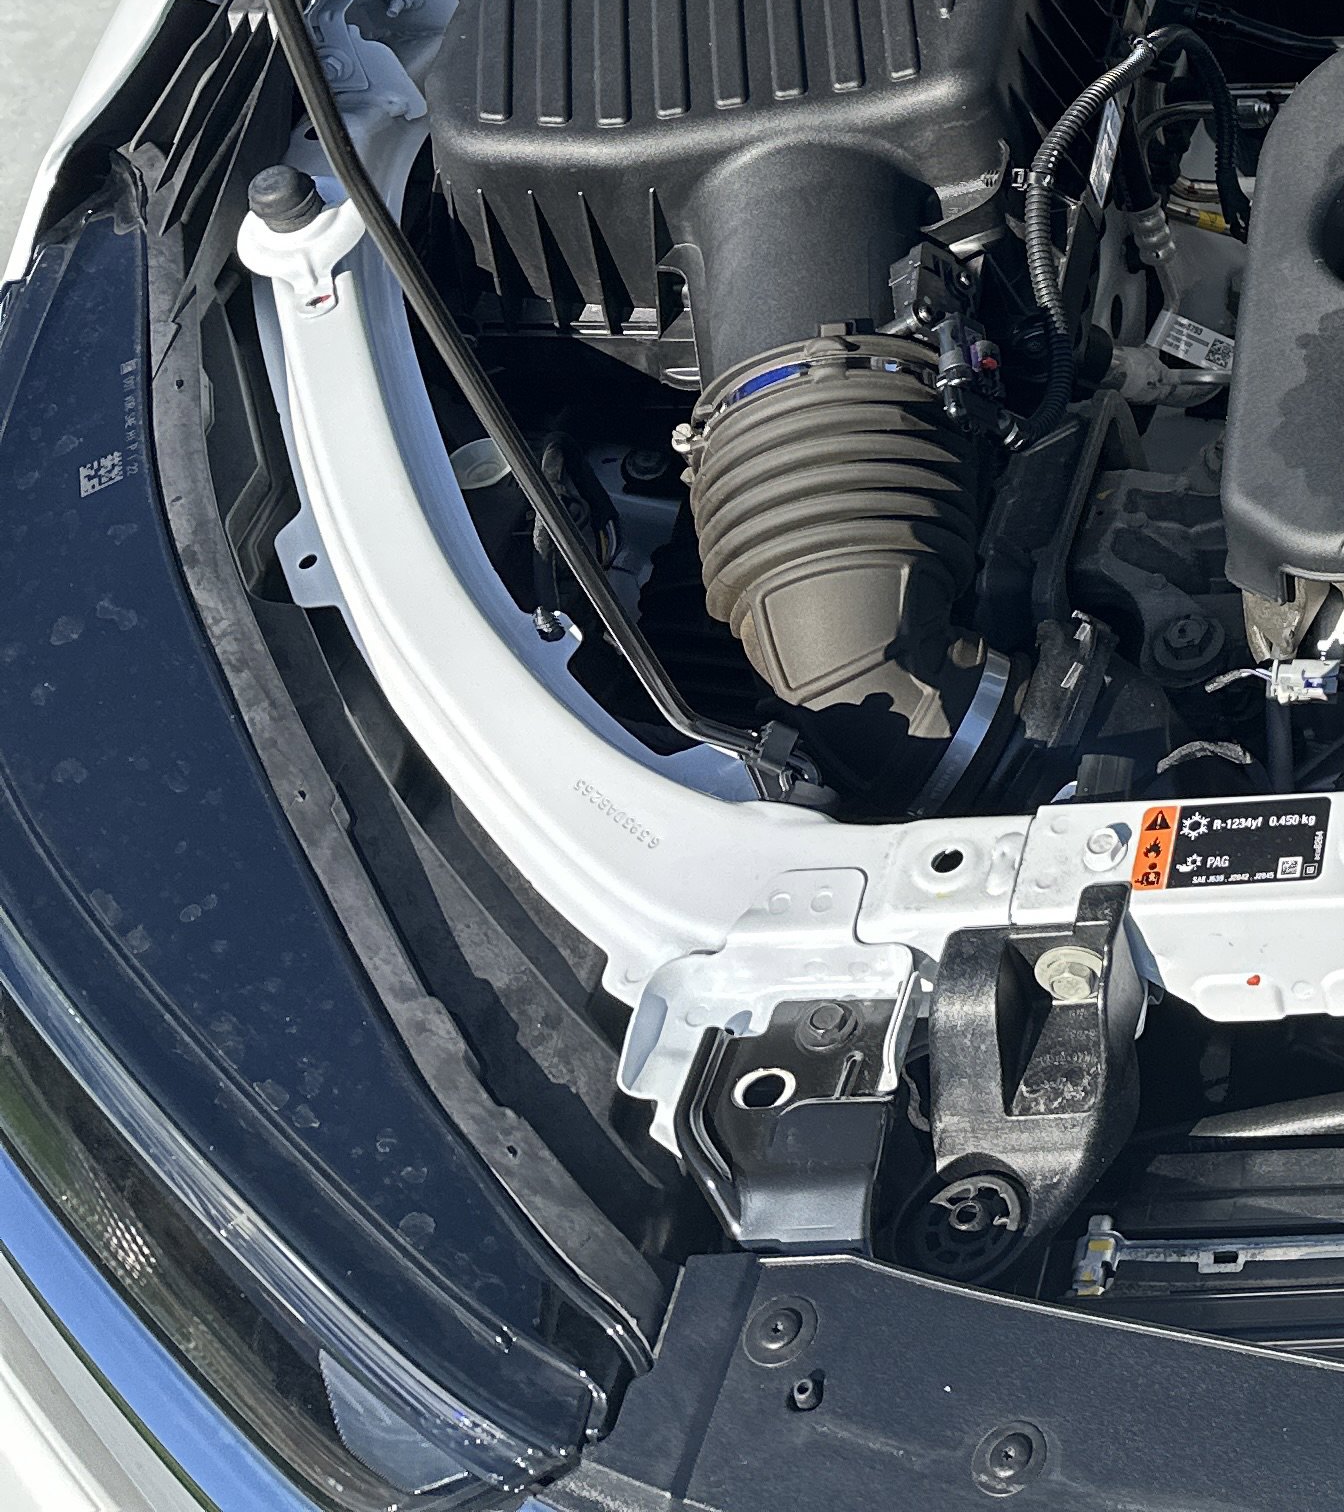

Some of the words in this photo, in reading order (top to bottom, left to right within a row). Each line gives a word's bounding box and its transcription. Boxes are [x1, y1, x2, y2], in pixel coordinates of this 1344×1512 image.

[1212, 816, 1263, 830] R-1234yf
[1268, 815, 1299, 827] 0.450
[1301, 814, 1316, 826] kg
[1206, 856, 1229, 868] PAG
